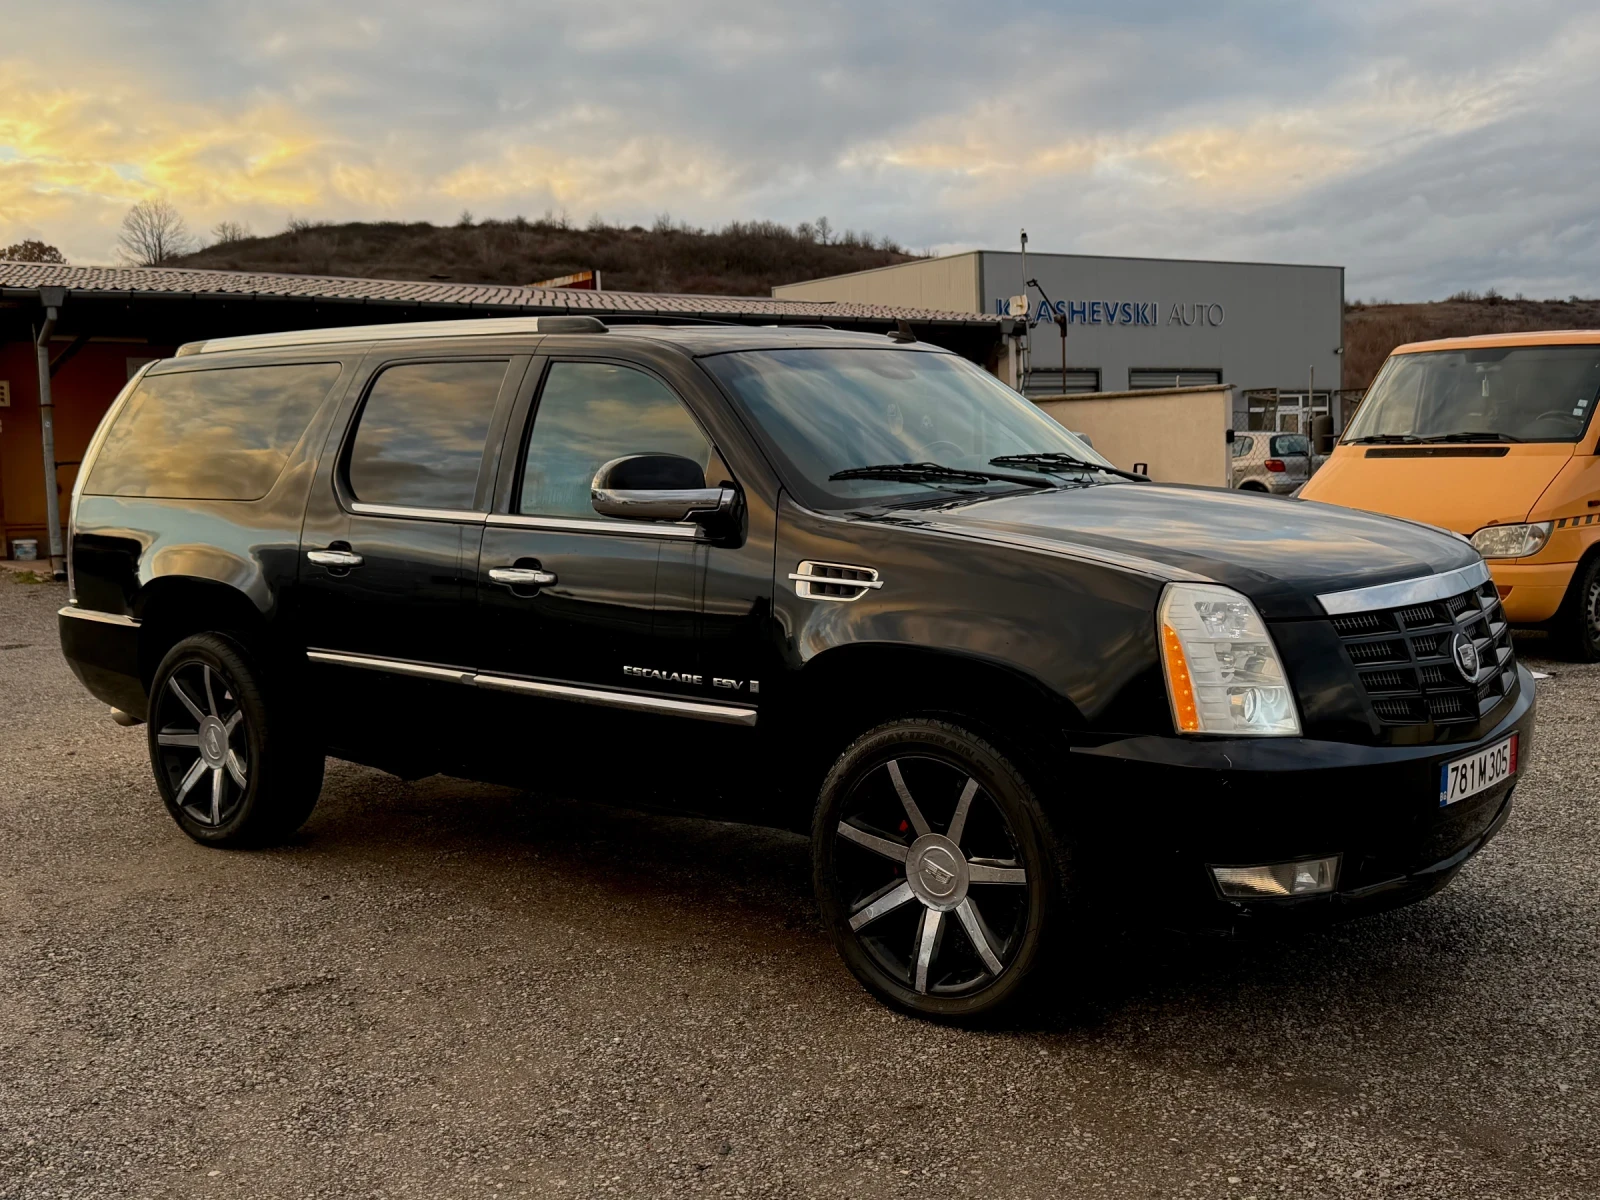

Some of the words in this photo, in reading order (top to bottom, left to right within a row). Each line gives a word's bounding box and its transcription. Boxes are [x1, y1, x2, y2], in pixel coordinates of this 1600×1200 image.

[995, 298, 1159, 326] KASHEVSKI
[1168, 303, 1226, 326] AUTO
[623, 665, 703, 685] ESCALADE
[713, 677, 744, 690] ESV
